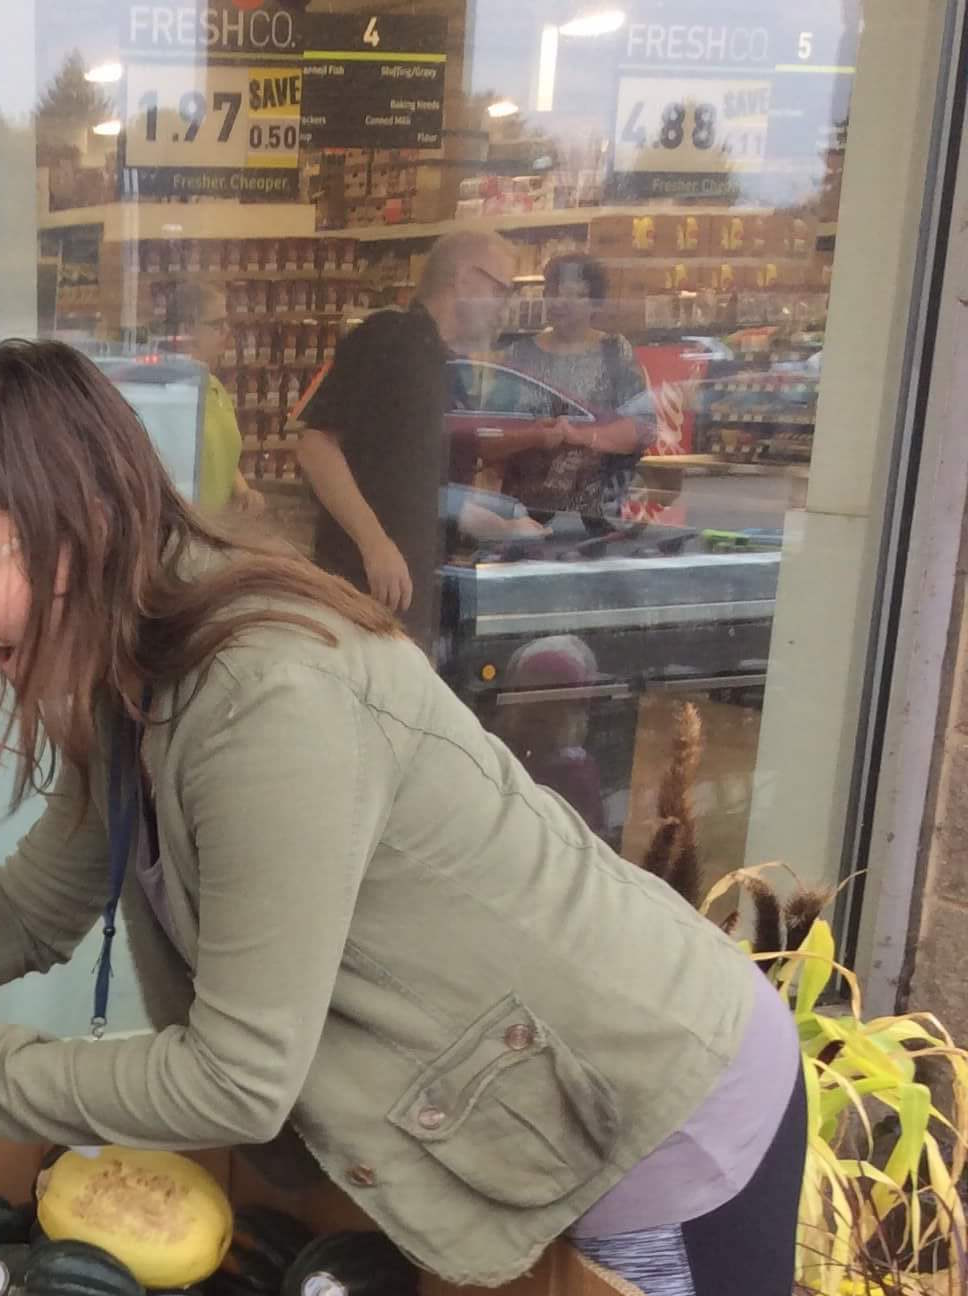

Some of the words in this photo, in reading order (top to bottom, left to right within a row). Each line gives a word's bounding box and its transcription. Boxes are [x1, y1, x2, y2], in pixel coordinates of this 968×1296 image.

[363, 16, 380, 47] 4
[798, 32, 813, 59] 5
[138, 90, 242, 142] 1.97
[620, 101, 716, 149] 4.88
[249, 125, 296, 149] 0.50
